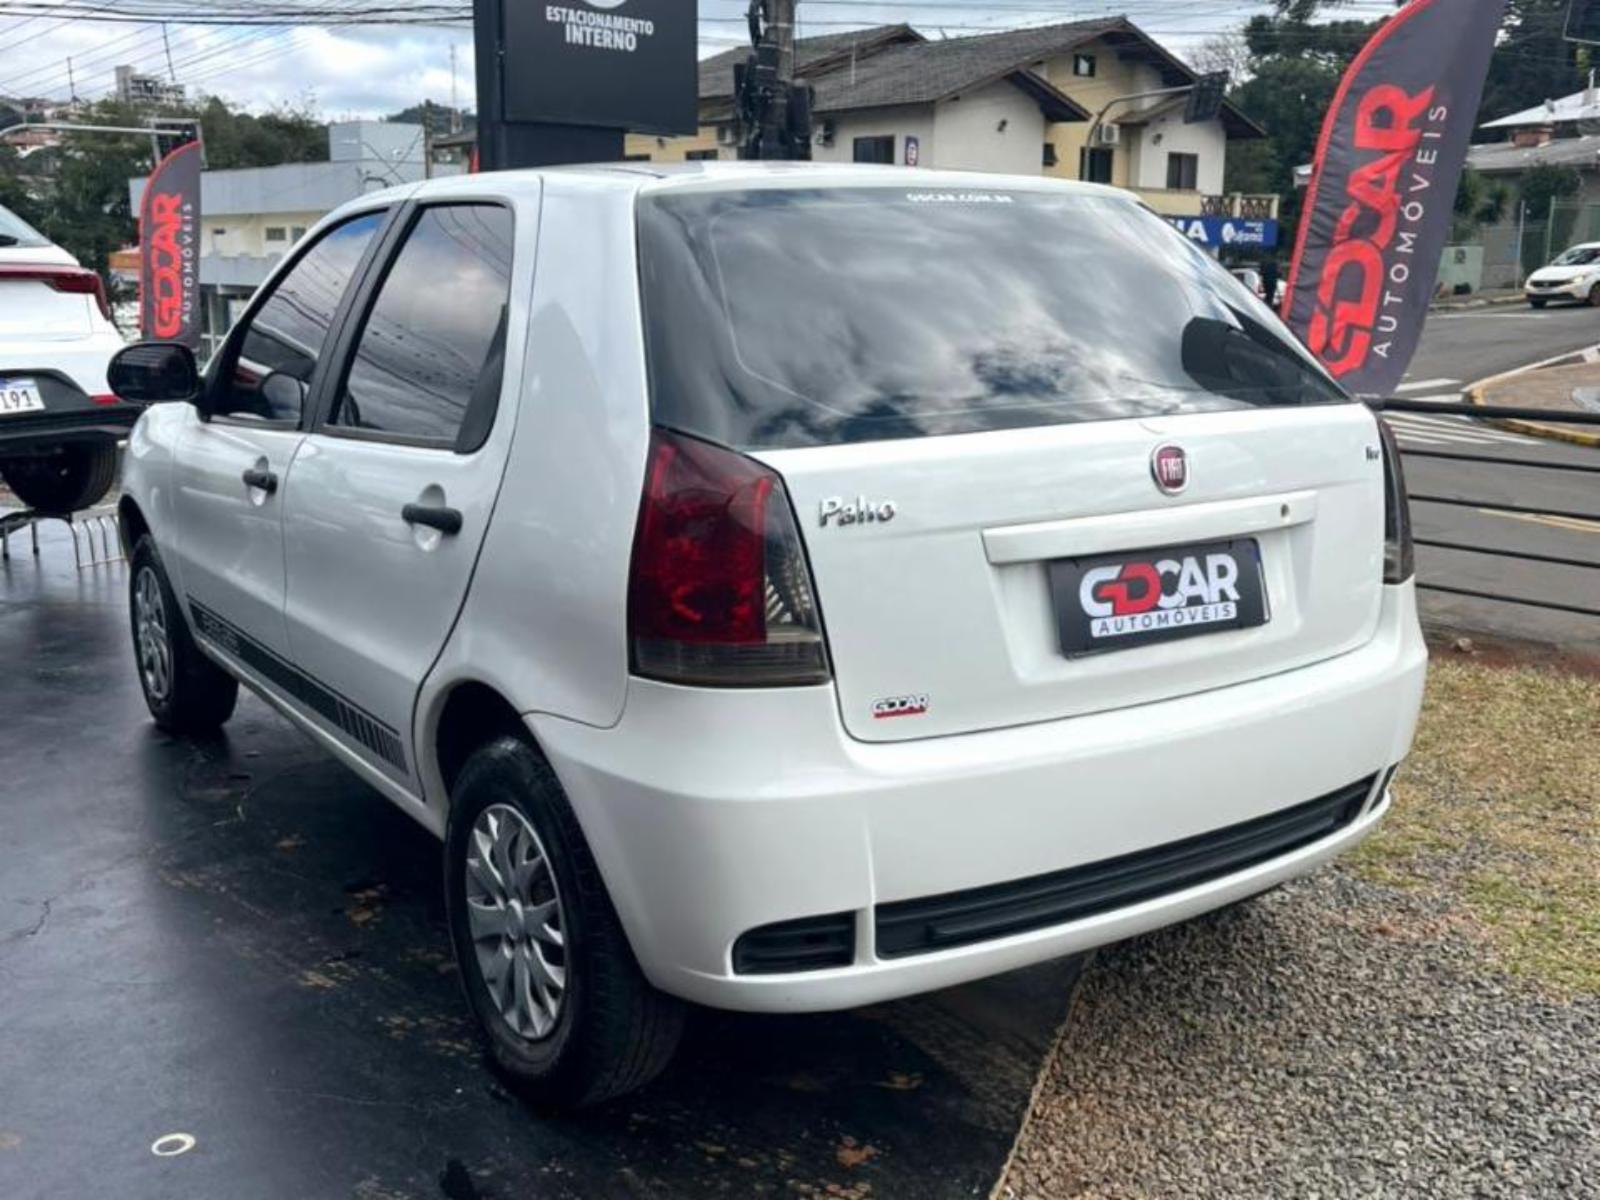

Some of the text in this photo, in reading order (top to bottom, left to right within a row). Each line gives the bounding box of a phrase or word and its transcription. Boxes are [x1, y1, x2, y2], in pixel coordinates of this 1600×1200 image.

[546, 5, 654, 36] ESTACIONAMENTO
[565, 24, 637, 52] INTERNO
[1373, 104, 1448, 359] AUTOMÓVEIS
[1160, 457, 1183, 482] FIAT
[818, 495, 896, 528] Palio
[1098, 602, 1233, 635] AUTOMÓVEIS
